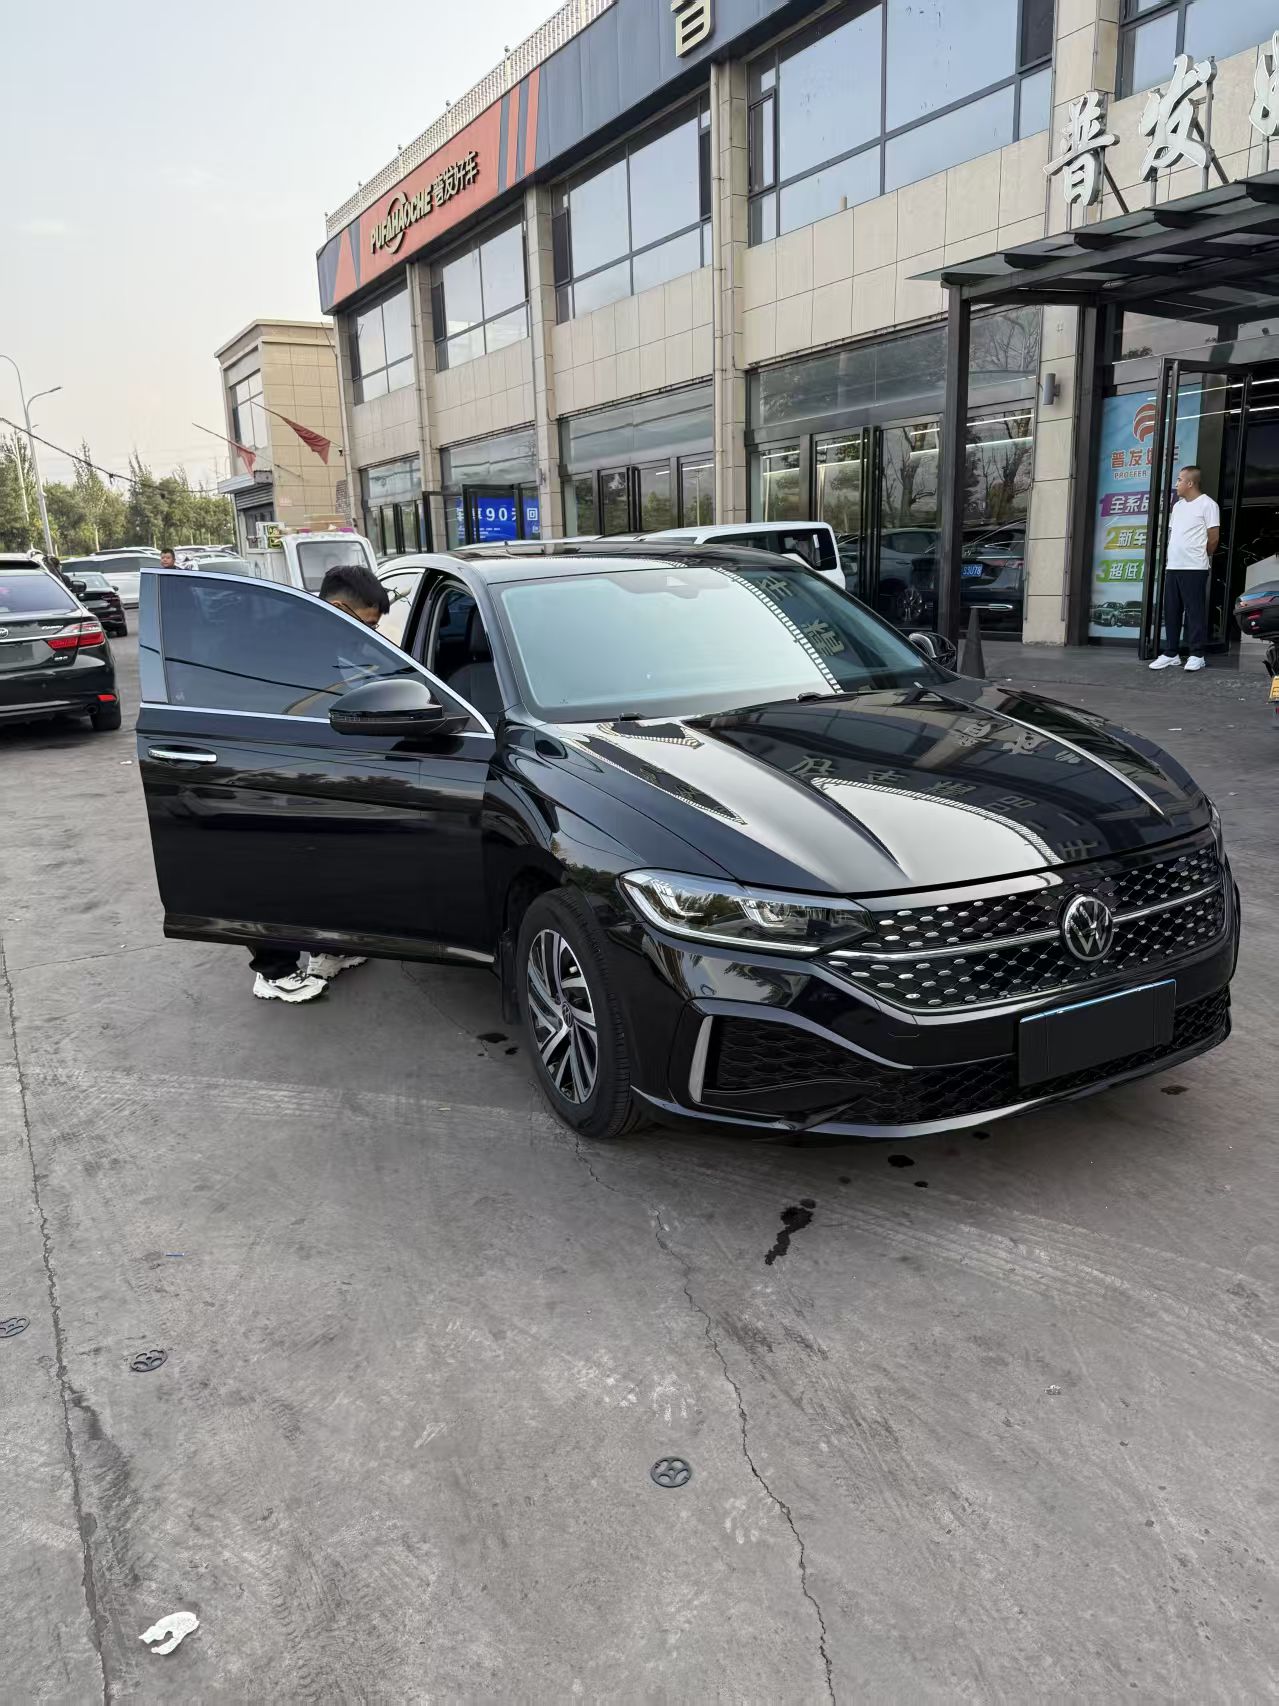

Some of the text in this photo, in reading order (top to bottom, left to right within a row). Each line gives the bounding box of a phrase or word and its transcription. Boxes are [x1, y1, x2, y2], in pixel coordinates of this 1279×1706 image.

[370, 151, 479, 253] PUFAHAOCHE 普发好车
[1109, 562, 1145, 579] 超低
